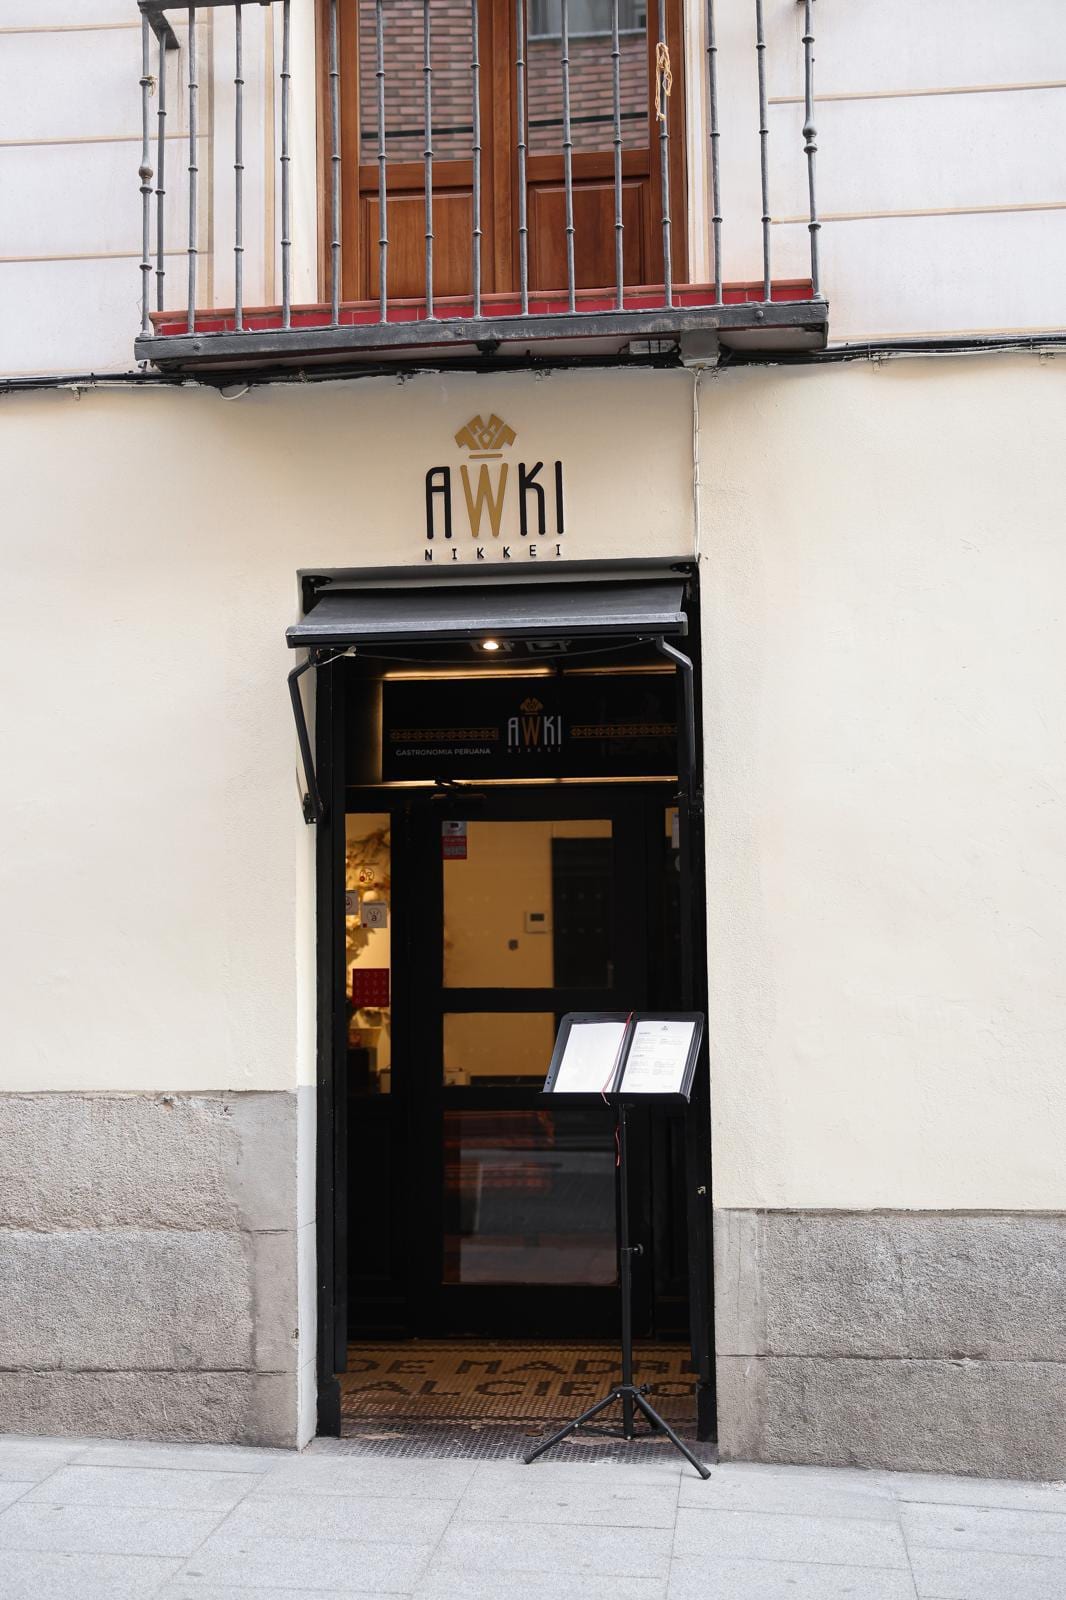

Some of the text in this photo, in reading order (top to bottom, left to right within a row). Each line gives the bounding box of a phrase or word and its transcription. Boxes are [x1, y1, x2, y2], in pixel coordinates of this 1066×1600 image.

[425, 460, 564, 540] AWKI
[424, 544, 561, 561] NIKKEI
[507, 715, 562, 746] AWKI
[454, 747, 492, 756] PERUANA
